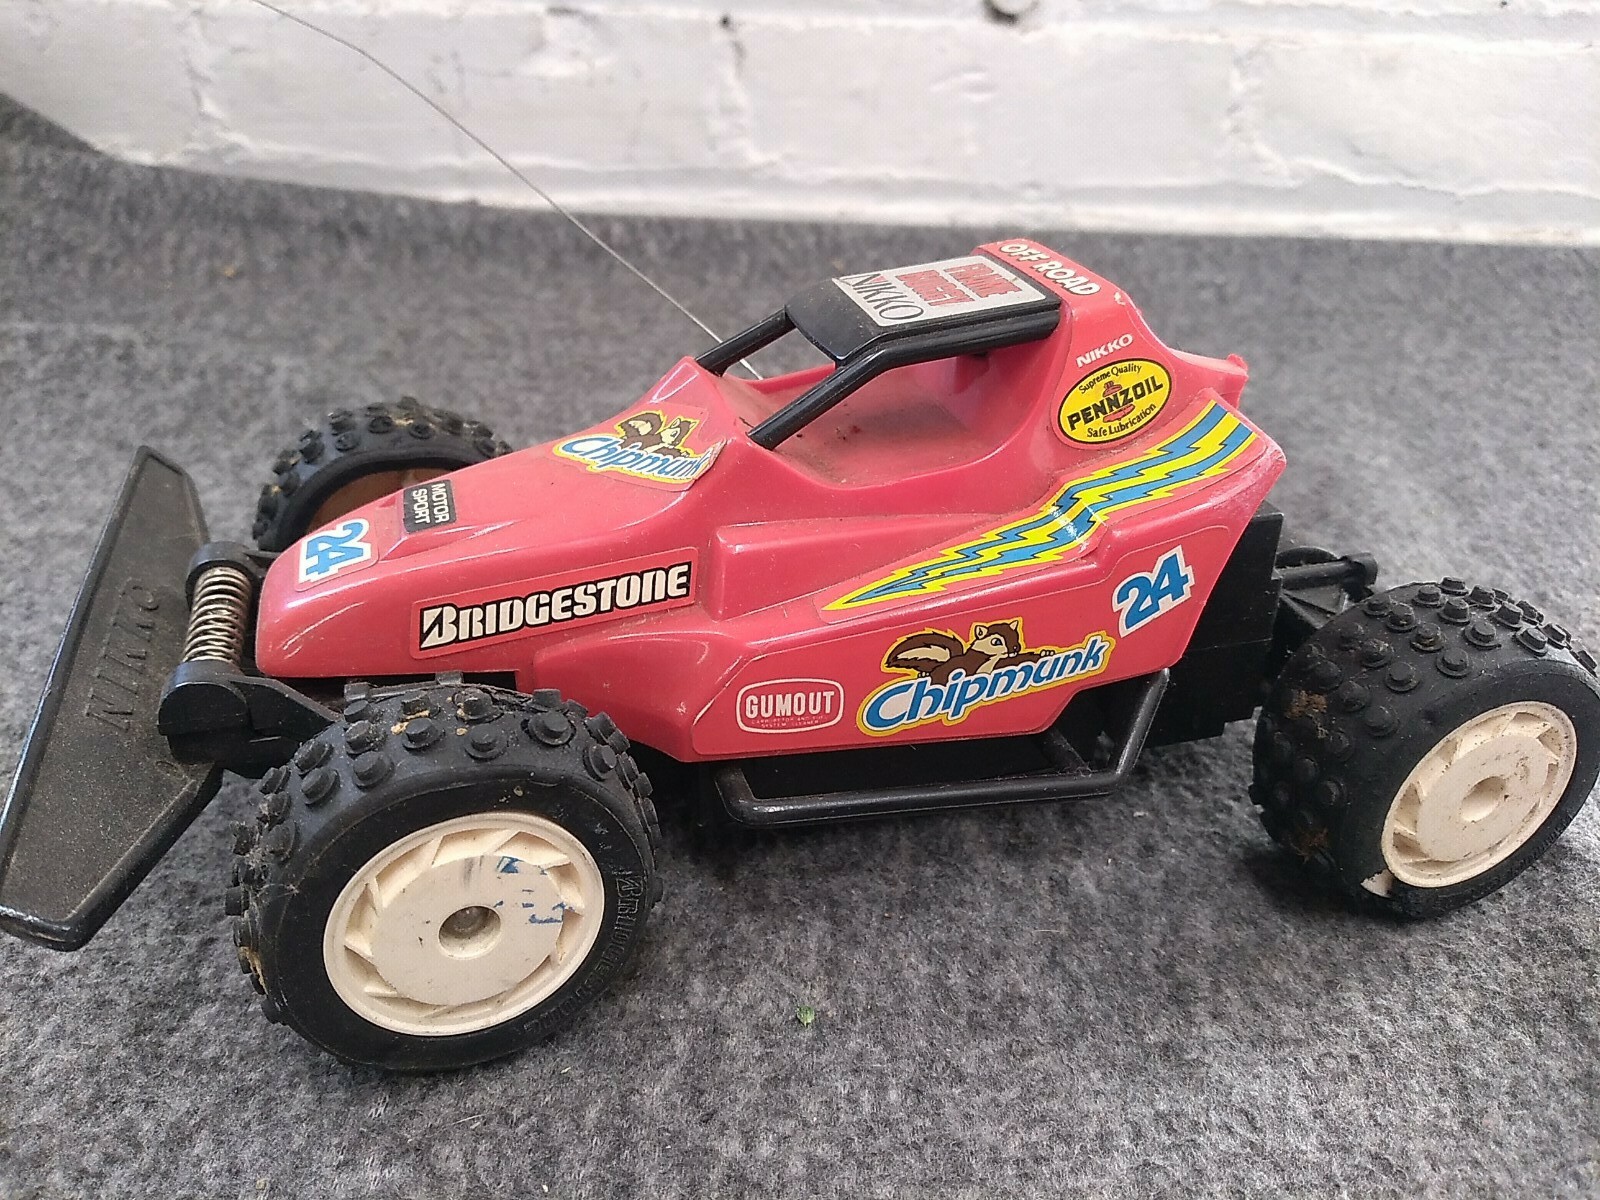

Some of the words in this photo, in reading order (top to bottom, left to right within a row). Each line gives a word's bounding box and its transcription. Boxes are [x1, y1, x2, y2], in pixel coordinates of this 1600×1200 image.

[1000, 243, 1049, 266] OFF
[1037, 260, 1101, 295] ROAD
[838, 272, 924, 320] NIKKO
[1076, 333, 1133, 367] NIKKO
[1079, 370, 1111, 394] Supreme
[1111, 362, 1142, 376] Quality
[1067, 376, 1163, 431] PENNZOIL
[1087, 427, 1107, 438] Safe
[1108, 403, 1156, 434] Lubrication
[561, 436, 713, 478] Chipmunk
[412, 488, 431, 524] SPORT
[431, 482, 450, 524] MOTOR
[303, 519, 369, 580] 24
[420, 563, 690, 649] BRIDGESTONE
[1114, 549, 1192, 631] 24
[745, 690, 835, 719] GUMOUT
[863, 636, 1109, 730] Chipmunk
